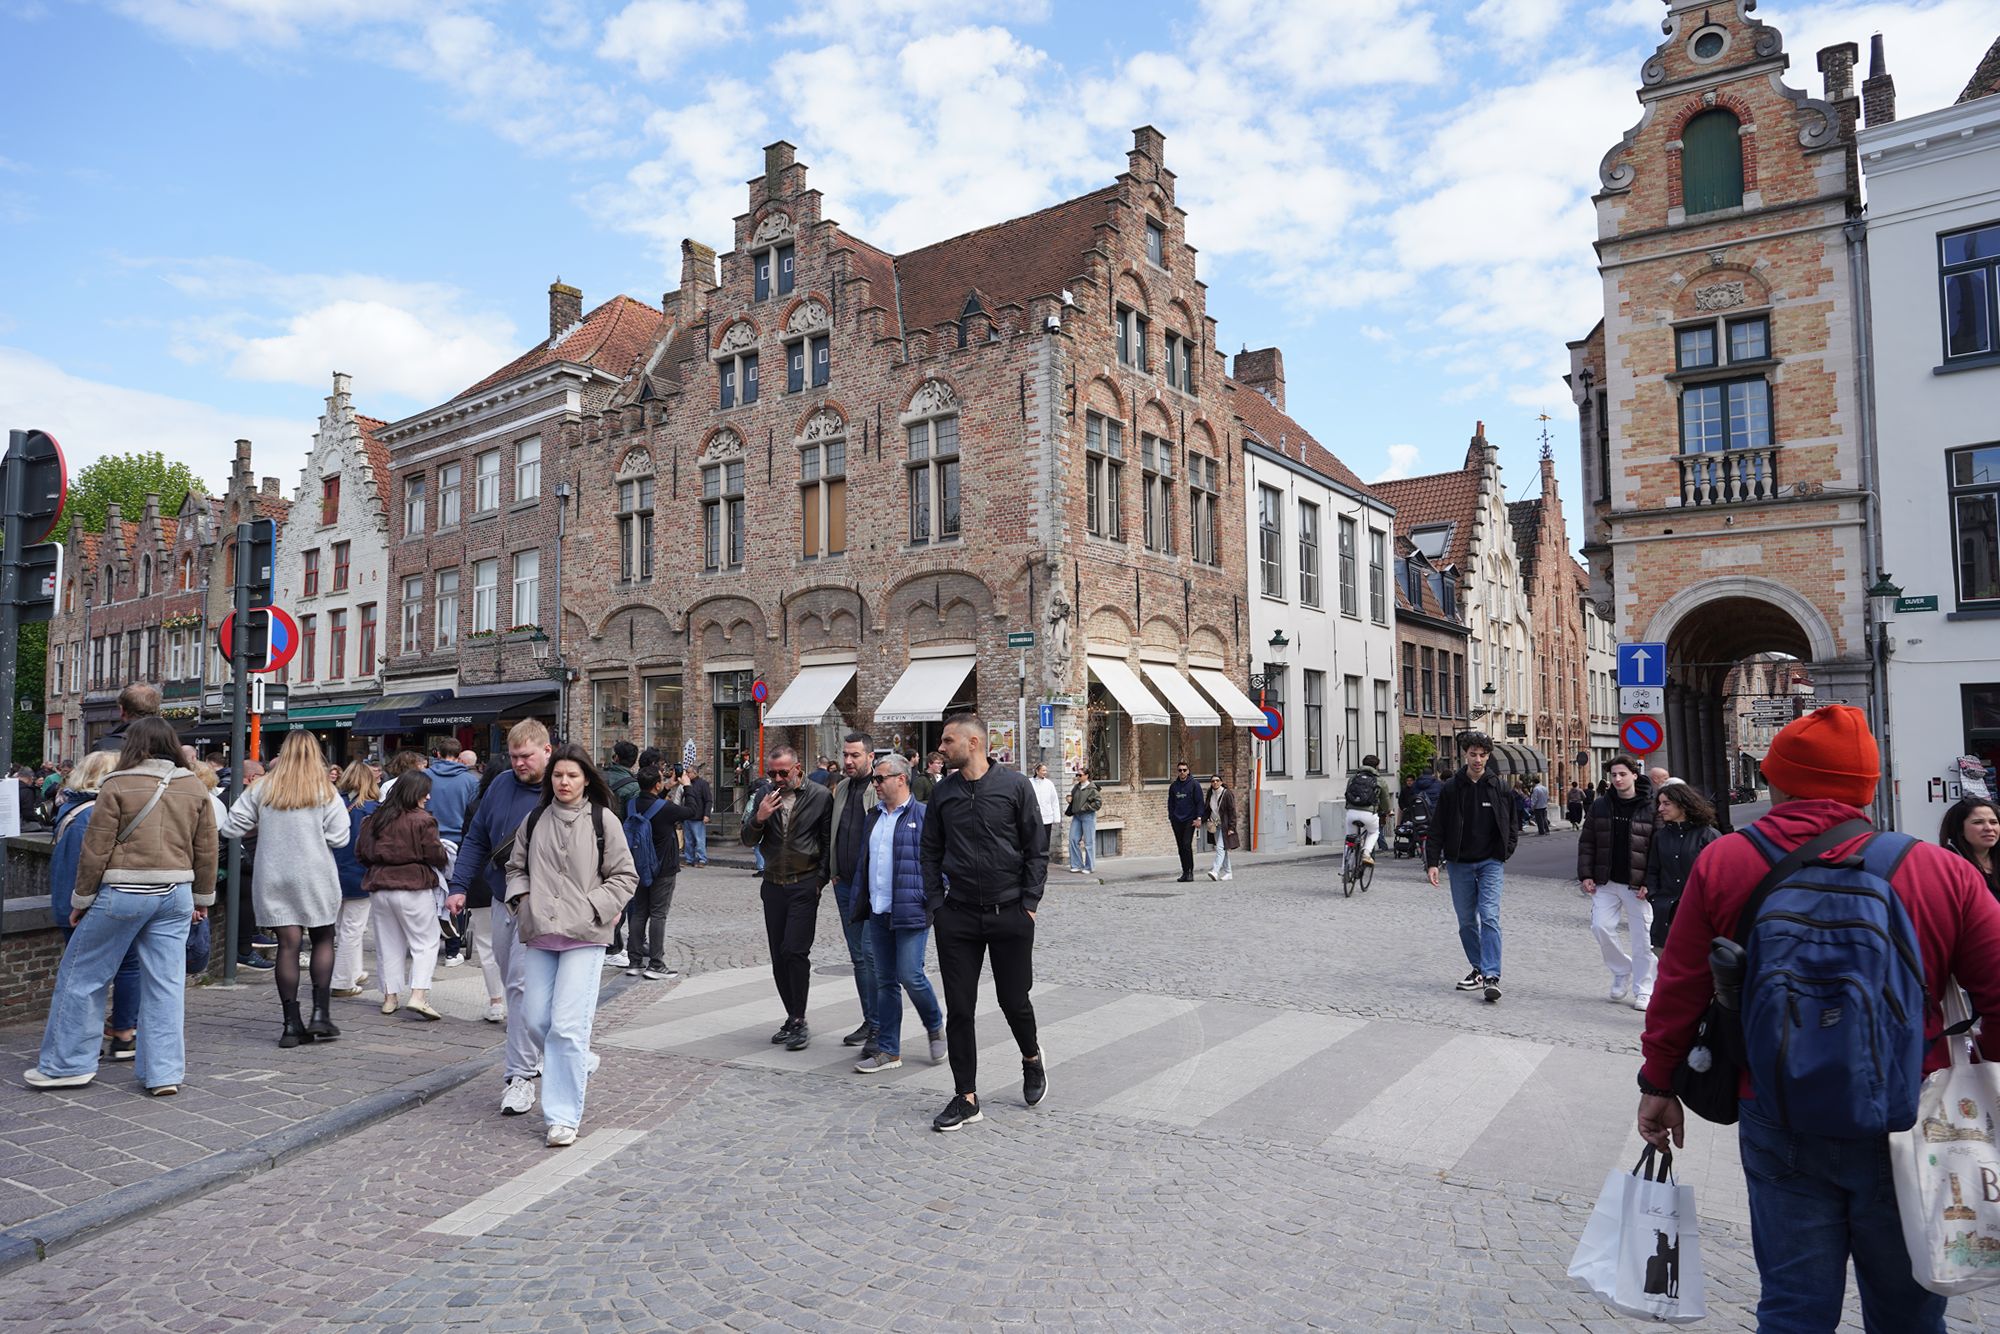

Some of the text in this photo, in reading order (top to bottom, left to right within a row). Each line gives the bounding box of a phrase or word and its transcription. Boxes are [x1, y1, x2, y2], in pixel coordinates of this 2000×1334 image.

[423, 716, 473, 725] BELGIAN HERITAGE
[1952, 785, 1959, 797] 1
